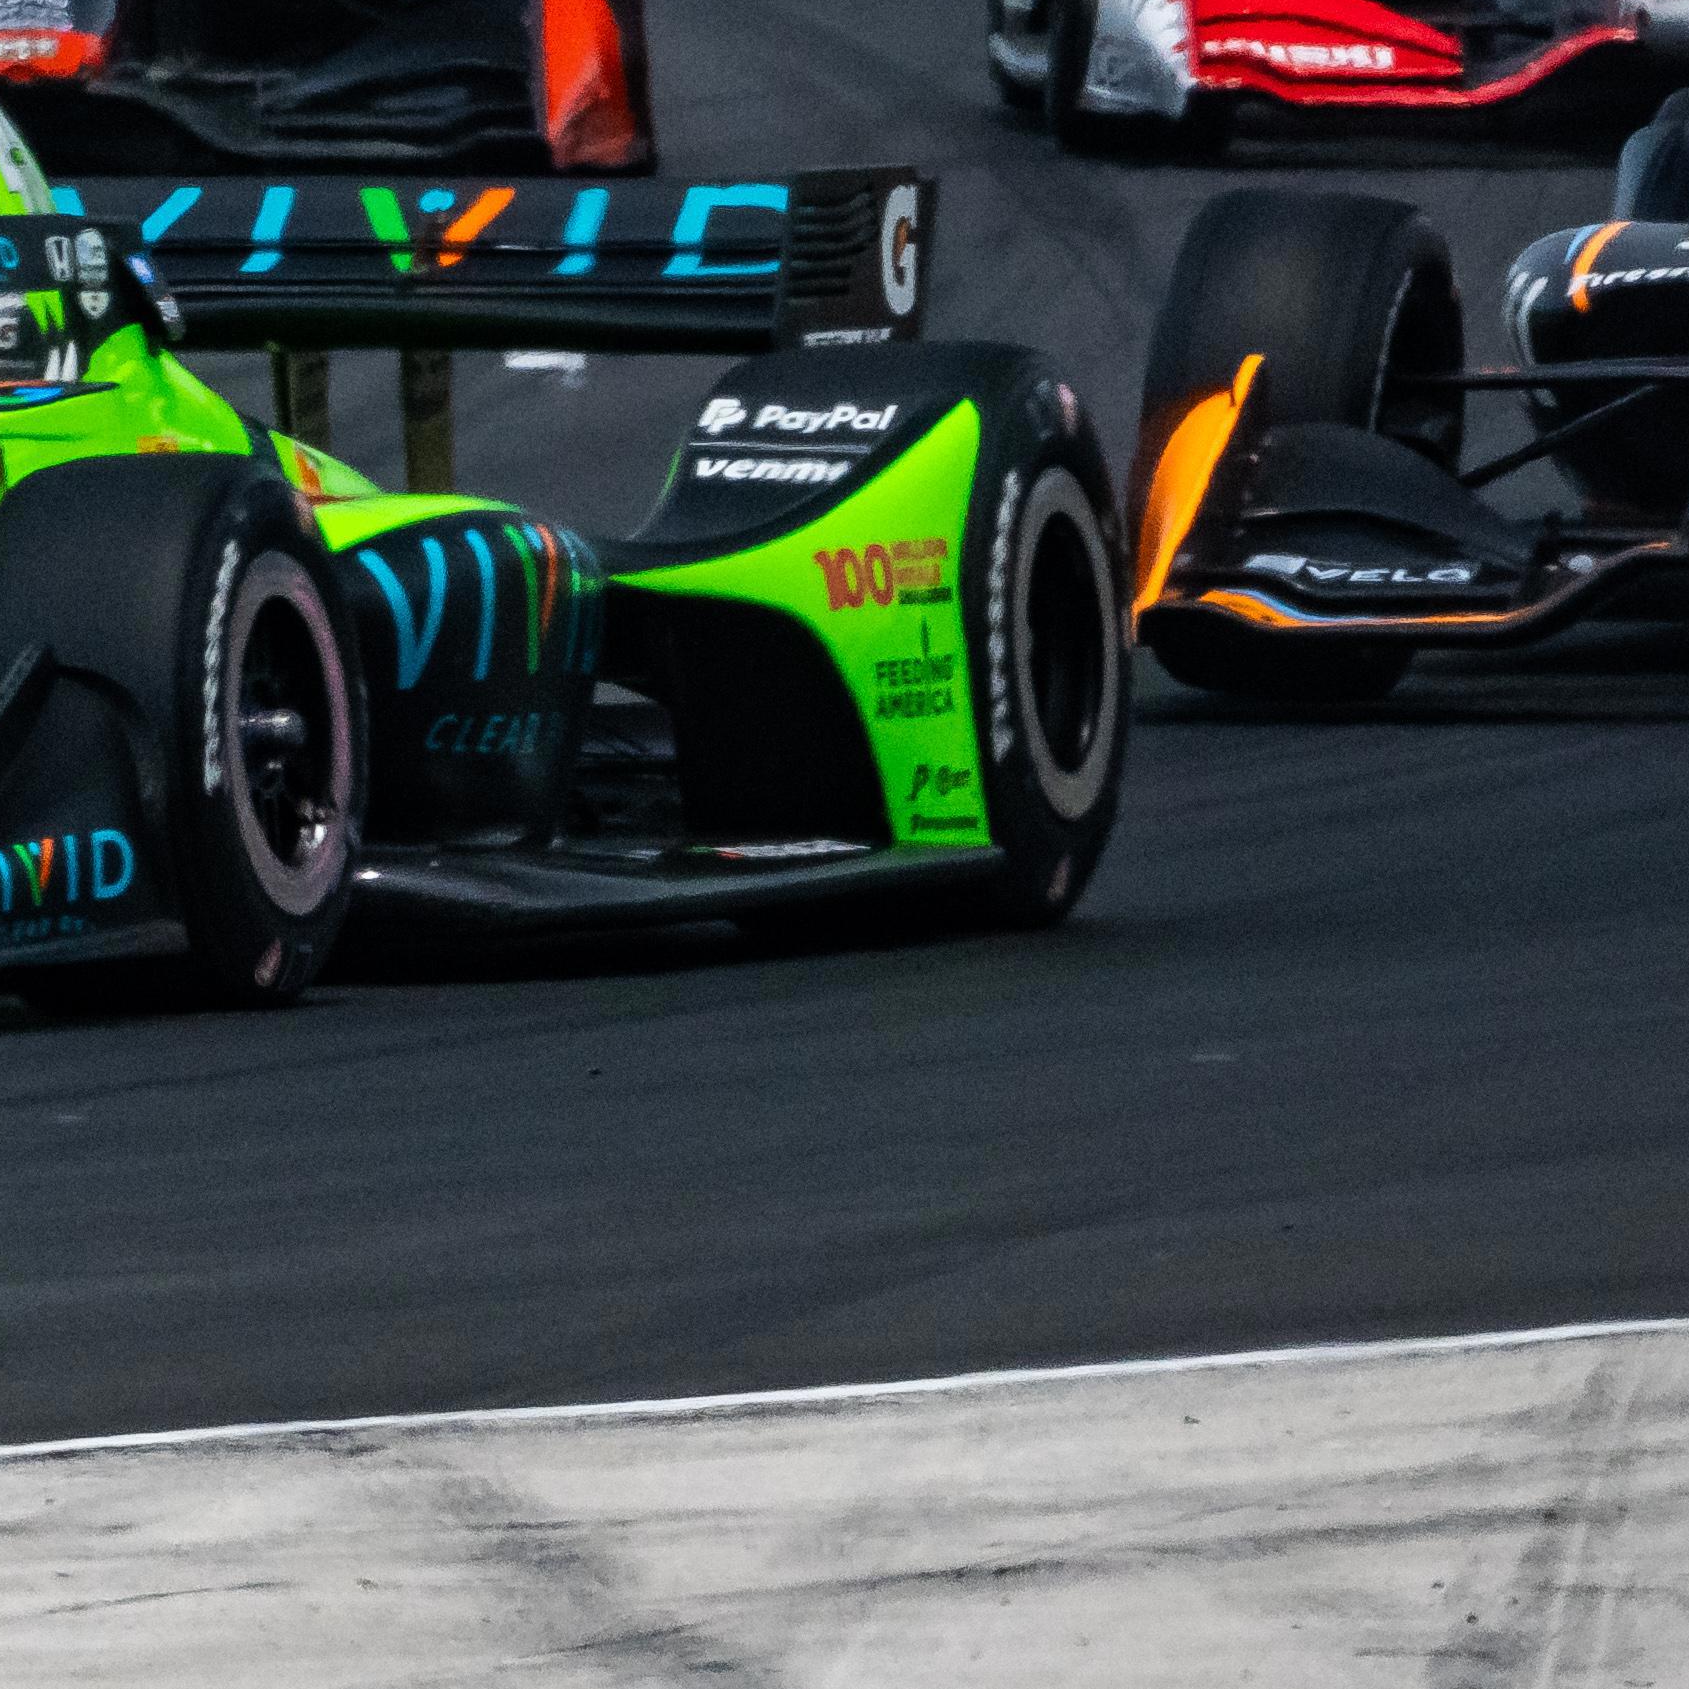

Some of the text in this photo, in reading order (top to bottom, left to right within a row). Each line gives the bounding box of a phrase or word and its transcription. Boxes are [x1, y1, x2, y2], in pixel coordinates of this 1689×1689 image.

[753, 403, 899, 433] PayPal
[814, 544, 894, 611] 100
[1305, 564, 1472, 583] VELO
